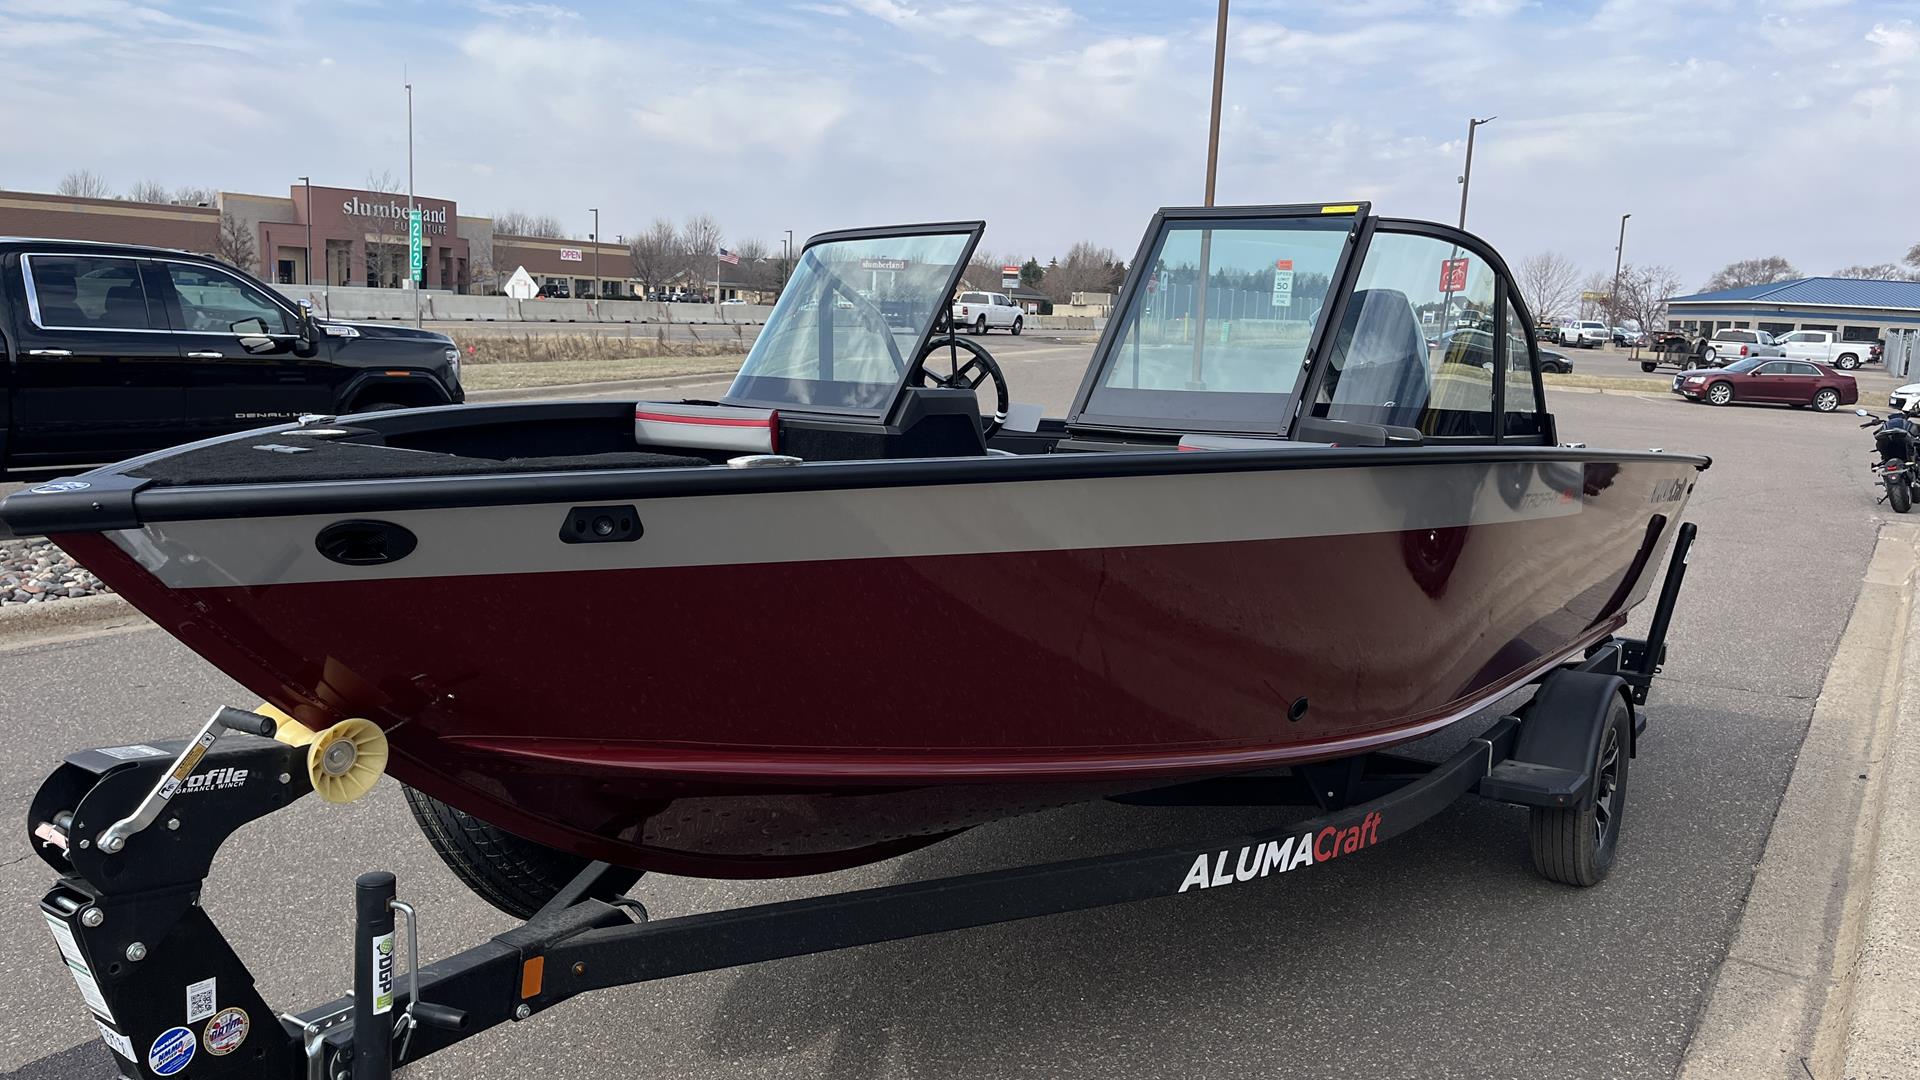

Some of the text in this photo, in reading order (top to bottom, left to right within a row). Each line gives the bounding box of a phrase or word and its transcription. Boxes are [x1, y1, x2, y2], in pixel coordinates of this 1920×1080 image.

[343, 197, 446, 223] slumbeand
[395, 222, 447, 235] FUITURE
[562, 250, 581, 259] OPEN
[862, 261, 905, 269] slumberland
[1276, 282, 1288, 290] 50
[184, 767, 249, 788] ofile
[175, 781, 245, 795] ORMANCE WINCH
[1178, 811, 1383, 893] ALUMACraft
[379, 955, 393, 994] DGP
